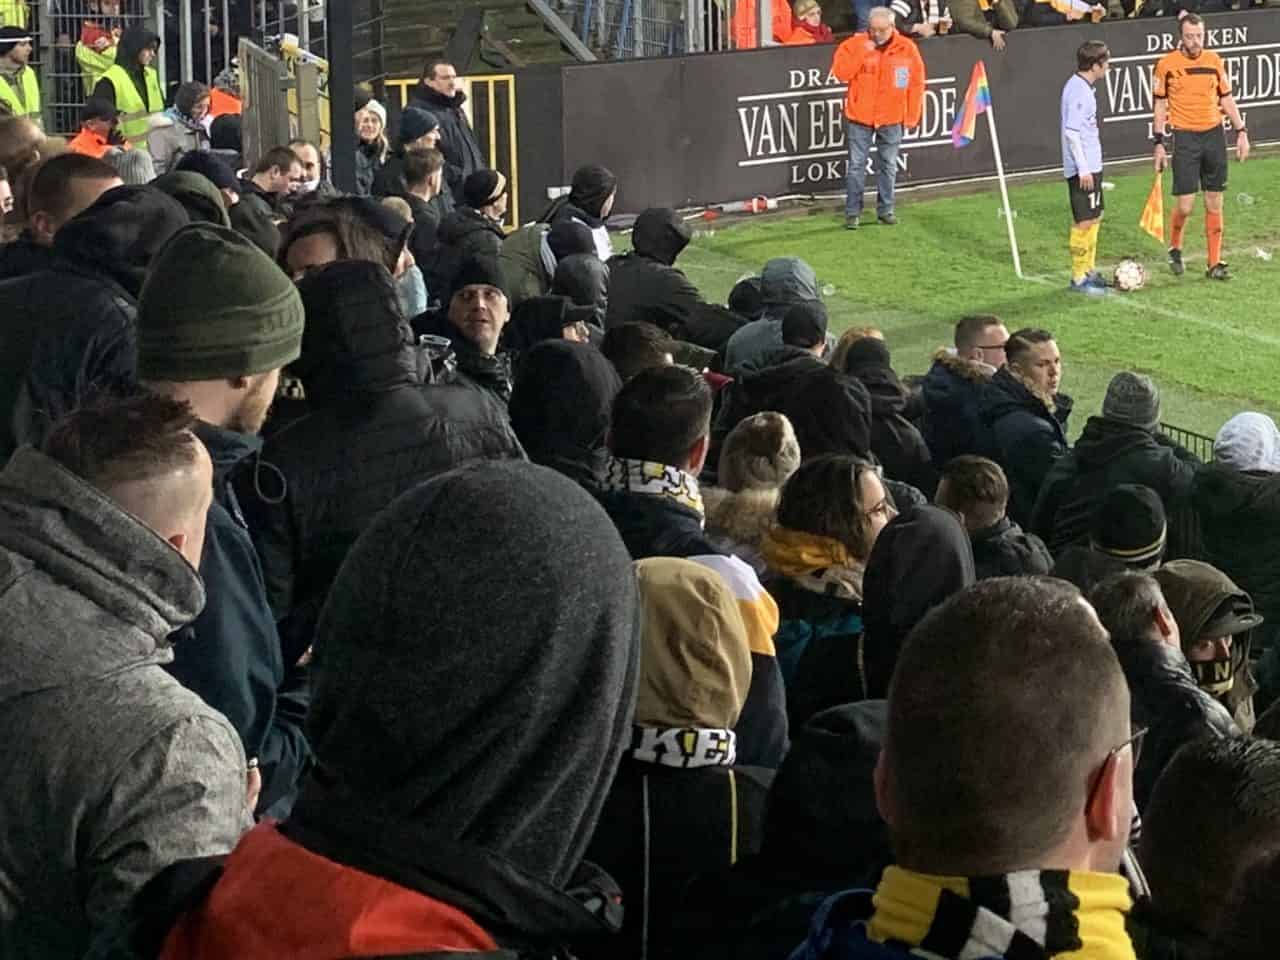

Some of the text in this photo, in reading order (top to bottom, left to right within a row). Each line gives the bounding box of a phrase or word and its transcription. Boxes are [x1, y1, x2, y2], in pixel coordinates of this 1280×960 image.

[1146, 26, 1248, 52] DRKEN
[1104, 63, 1154, 114] VAN
[737, 102, 800, 159] VAN
[791, 152, 909, 184] LOKRN
